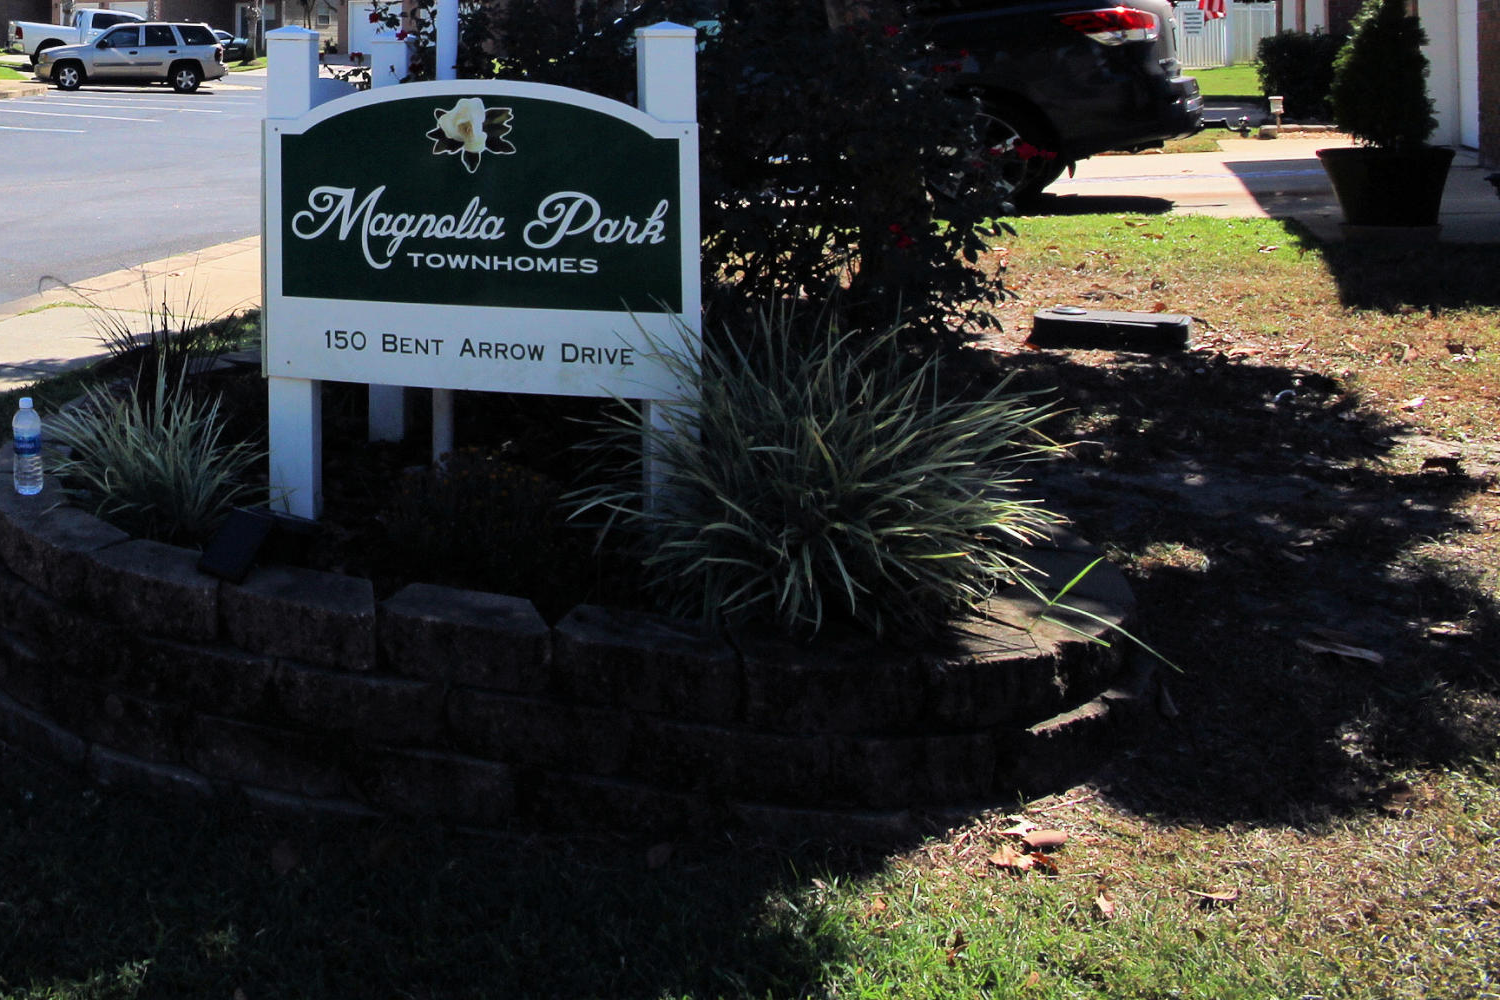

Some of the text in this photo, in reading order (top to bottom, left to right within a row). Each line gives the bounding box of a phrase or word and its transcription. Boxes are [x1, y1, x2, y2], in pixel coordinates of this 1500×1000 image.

[291, 185, 670, 270] Magnolia Park
[406, 252, 598, 274] TOWNHOMES
[324, 330, 635, 366] 150 BENT ARROW DRIVE
